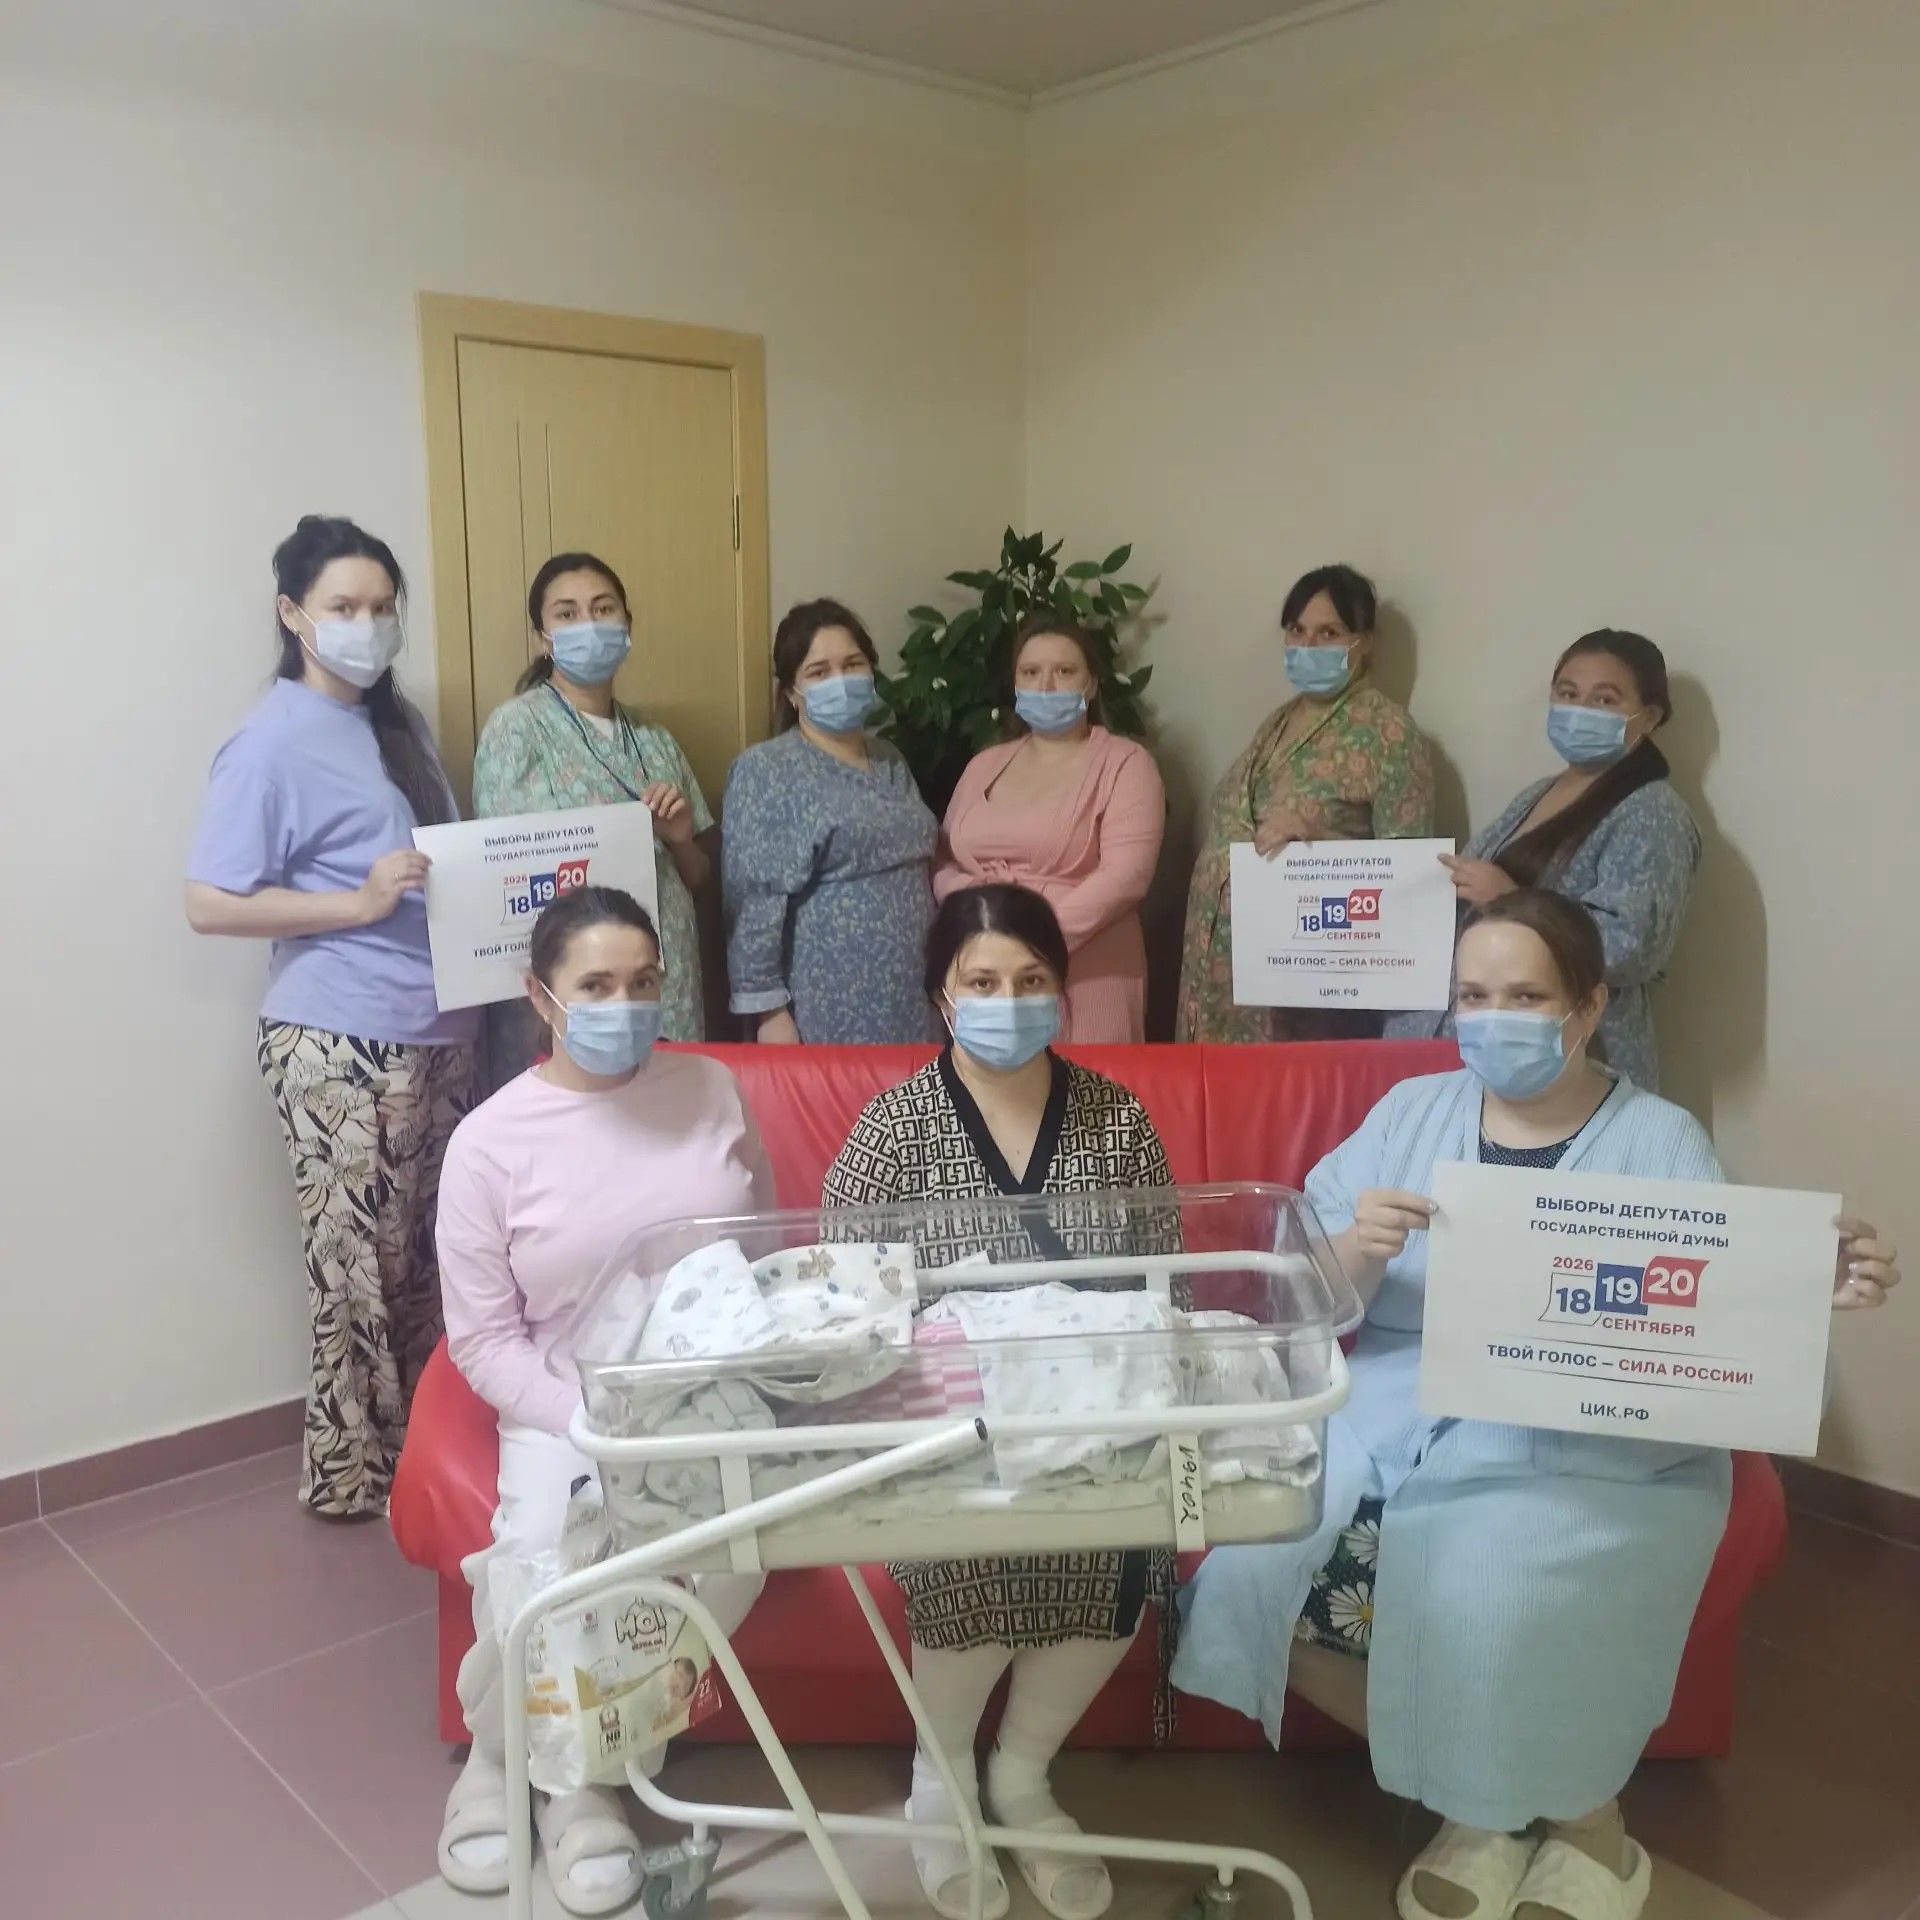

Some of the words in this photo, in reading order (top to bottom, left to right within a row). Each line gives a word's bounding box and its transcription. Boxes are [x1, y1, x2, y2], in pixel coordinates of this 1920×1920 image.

[485, 833, 531, 847] ВЫБОРЫ
[534, 826, 595, 843] ДЕПУТАТОВ
[485, 844, 571, 862] ГОСУДАРСТВЕННОЙ
[573, 841, 599, 852] ДУМЫ
[1286, 859, 1330, 868] ВЫБОРЫ
[1332, 858, 1392, 868] ДЕПУТАТОВ
[503, 875, 528, 885] 2026
[1284, 872, 1366, 881] ГОСУДАРСТВЕННОЙ
[1368, 873, 1394, 881] ДУМЫ
[508, 896, 530, 915] 18
[533, 881, 556, 901] 19
[559, 867, 585, 889] 20
[1297, 896, 1320, 904] 2026
[1300, 915, 1321, 932] 18
[1325, 905, 1346, 923] 19
[1350, 896, 1377, 914] 20
[1327, 932, 1381, 940] СЕНТЯБРЯ
[474, 944, 502, 957] ТВОЙ
[1267, 956, 1292, 966] ТВОЙ
[1294, 958, 1327, 966] ГОЛОС
[1338, 958, 1367, 967] СИЛА
[1369, 959, 1415, 967] РОССИИ!
[1319, 988, 1359, 998] ЦИК.РФ
[1536, 1197, 1615, 1216] ВЫБОРЫ
[1619, 1204, 1727, 1226] ДЕПУТАТОВ
[1530, 1220, 1679, 1244] ГОСУДАРСТВЕННОЙ
[1682, 1233, 1729, 1249] ДУМЫ
[1552, 1256, 1594, 1272] 2026
[1555, 1287, 1592, 1315] 18
[1601, 1276, 1640, 1305] 19
[1647, 1267, 1696, 1297] 20
[1602, 1317, 1696, 1338] СЕНТЯБРЯ
[1487, 1344, 1534, 1362] ТВОЙ
[1538, 1349, 1598, 1368] ГОЛОС
[1618, 1358, 1668, 1376] СИЛА
[1672, 1364, 1754, 1386] РОССИИ!
[1580, 1402, 1650, 1422] ЦИК.РФ
